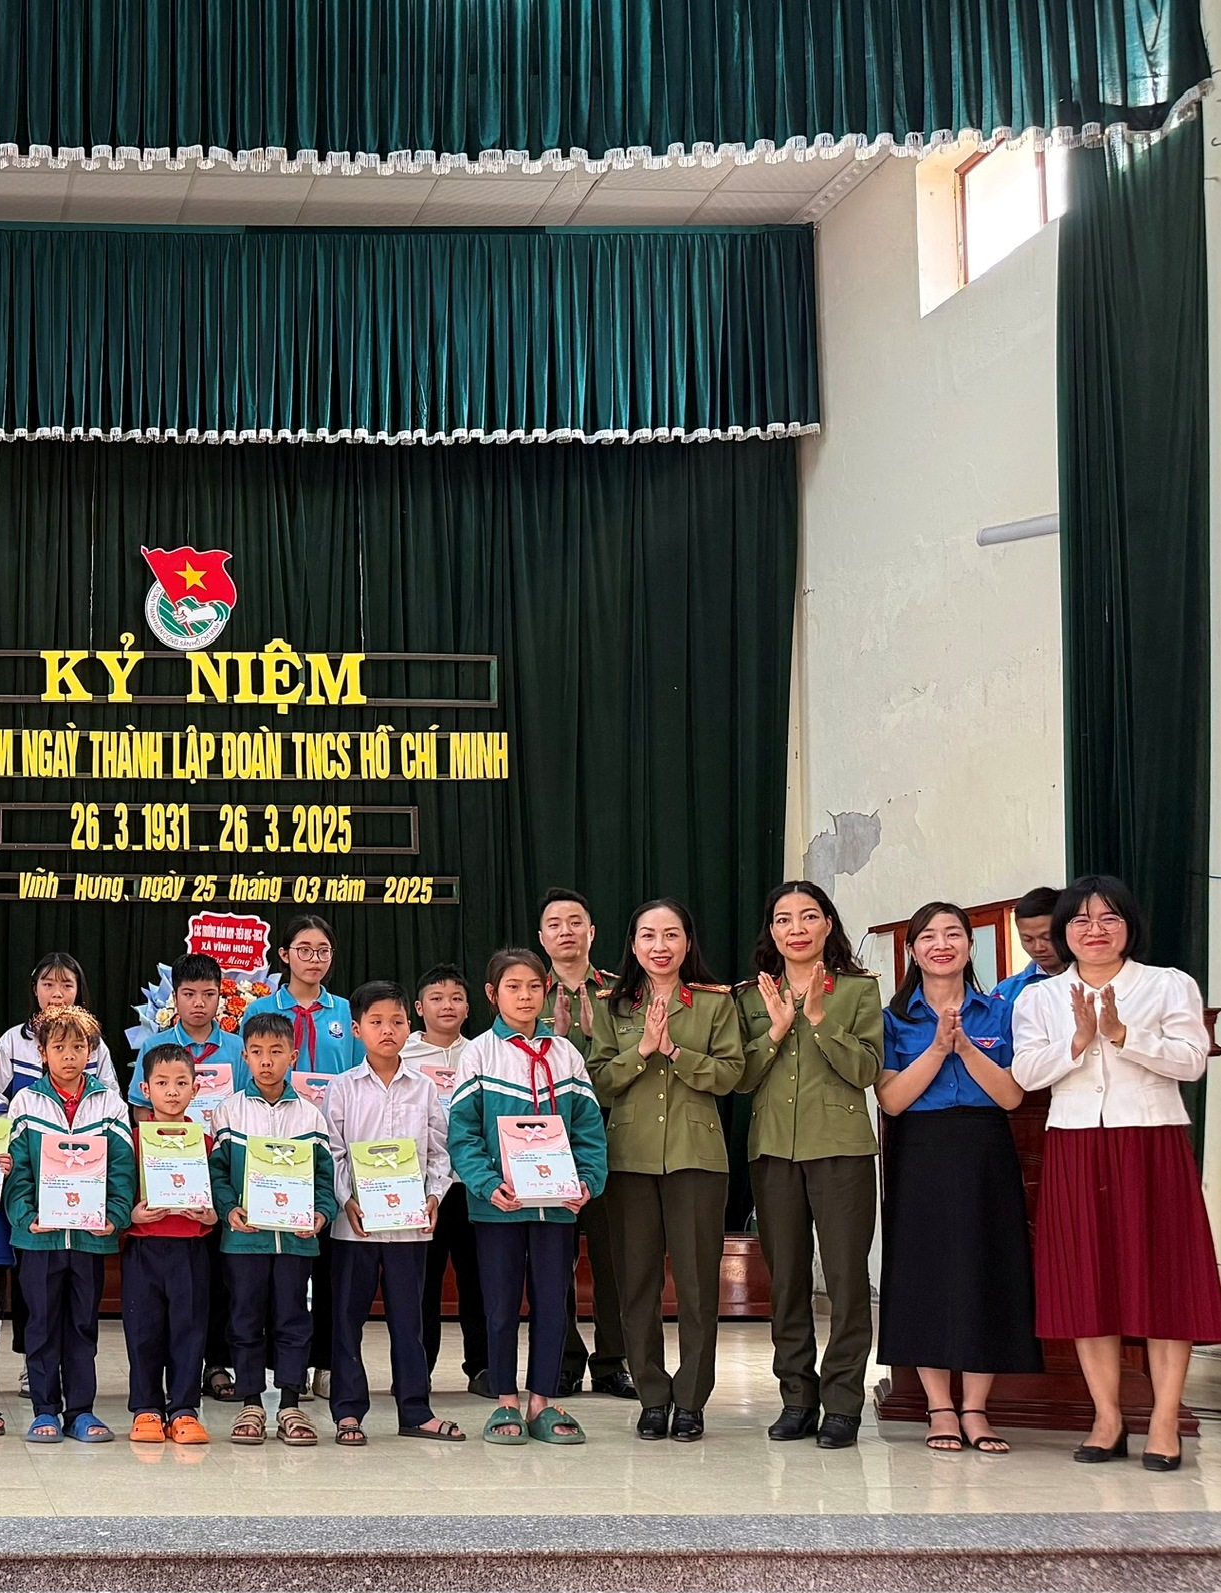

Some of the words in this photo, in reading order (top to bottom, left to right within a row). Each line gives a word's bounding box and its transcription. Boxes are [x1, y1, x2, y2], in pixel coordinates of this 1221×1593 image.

[40, 633, 144, 702] KỶ
[186, 638, 367, 714] NIỆM
[89, 724, 163, 779] THÀNH
[172, 724, 216, 784] LẬP
[222, 725, 282, 780] ĐOÀN
[291, 732, 351, 780] TNCS
[360, 724, 395, 780] HỒ
[401, 724, 440, 780] CHÍ
[450, 732, 508, 780] MINH
[19, 867, 59, 899] Vĩnh
[139, 869, 186, 902] ngày
[192, 875, 218, 902] 25
[228, 870, 283, 903] tháng
[293, 876, 321, 903] 03
[325, 874, 366, 902] năm
[383, 876, 433, 904] 2025
